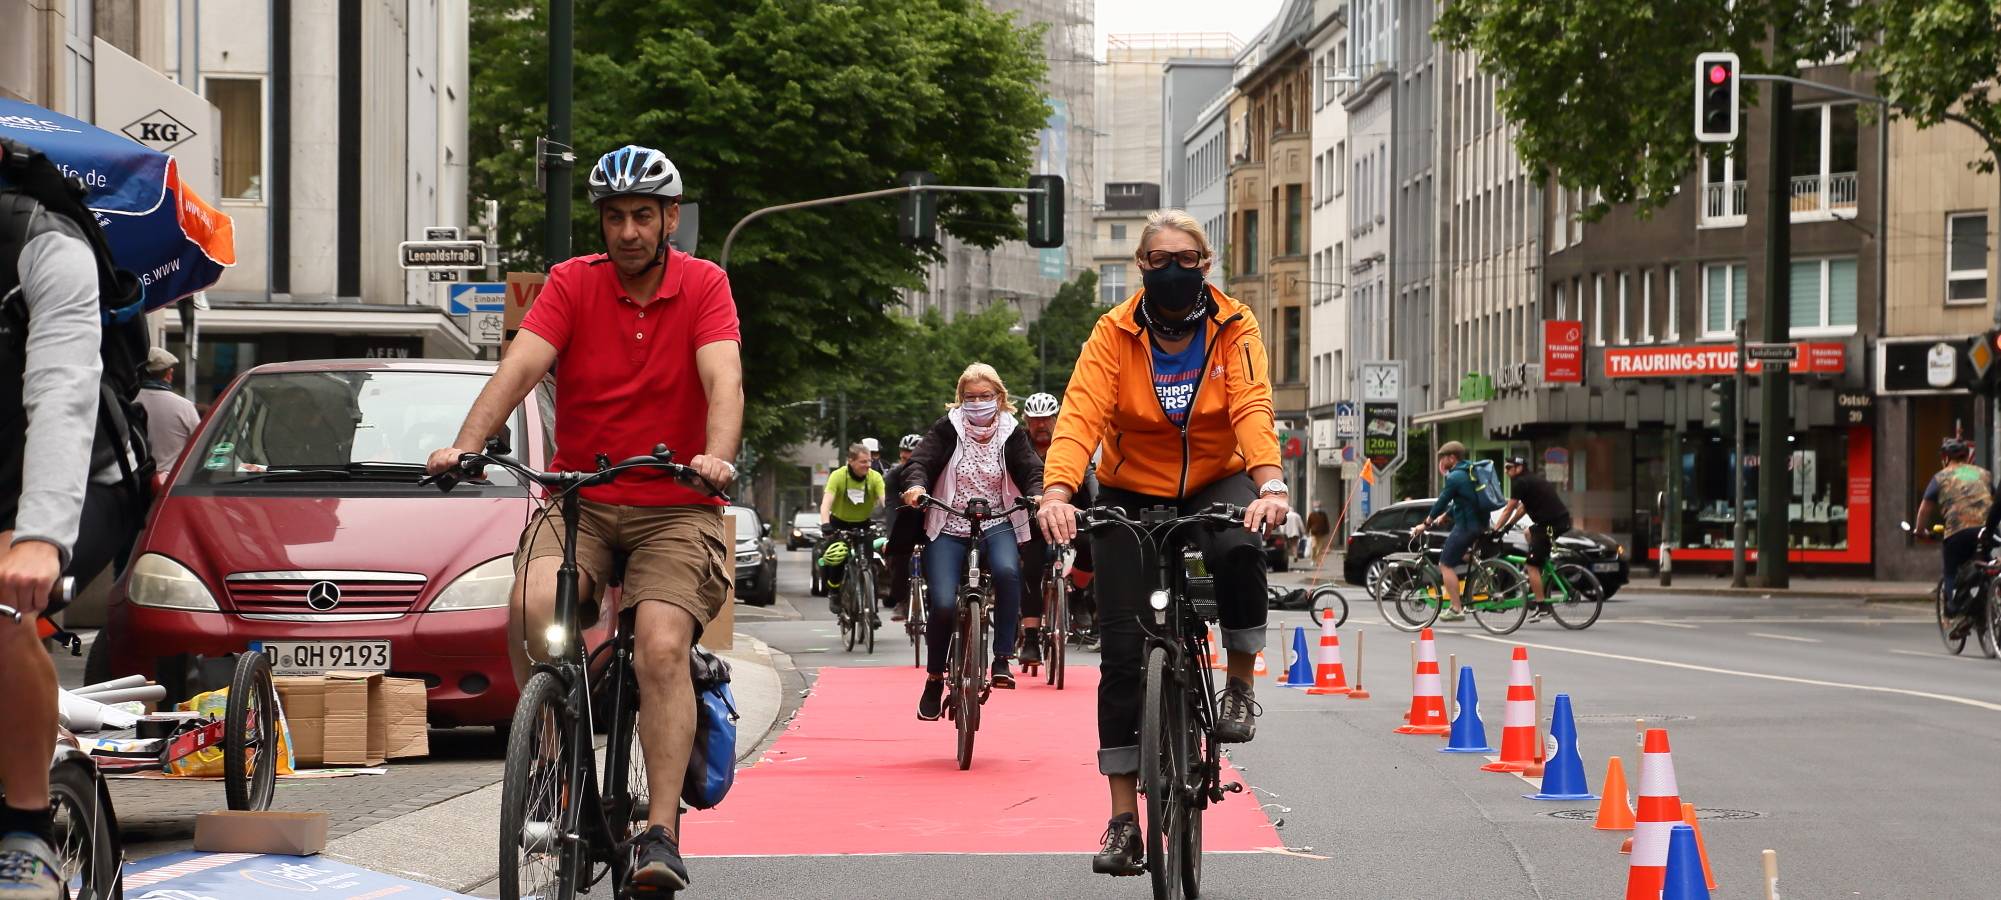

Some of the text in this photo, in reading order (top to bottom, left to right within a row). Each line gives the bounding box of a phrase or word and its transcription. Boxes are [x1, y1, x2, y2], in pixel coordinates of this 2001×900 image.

[139, 122, 179, 142] KG
[408, 248, 476, 263] Leopoldstraße
[1838, 394, 1872, 407] Oststr.
[1848, 410, 1863, 423] 39
[1370, 438, 1385, 449] 20
[294, 645, 324, 667] QH
[329, 644, 387, 667] 9193
